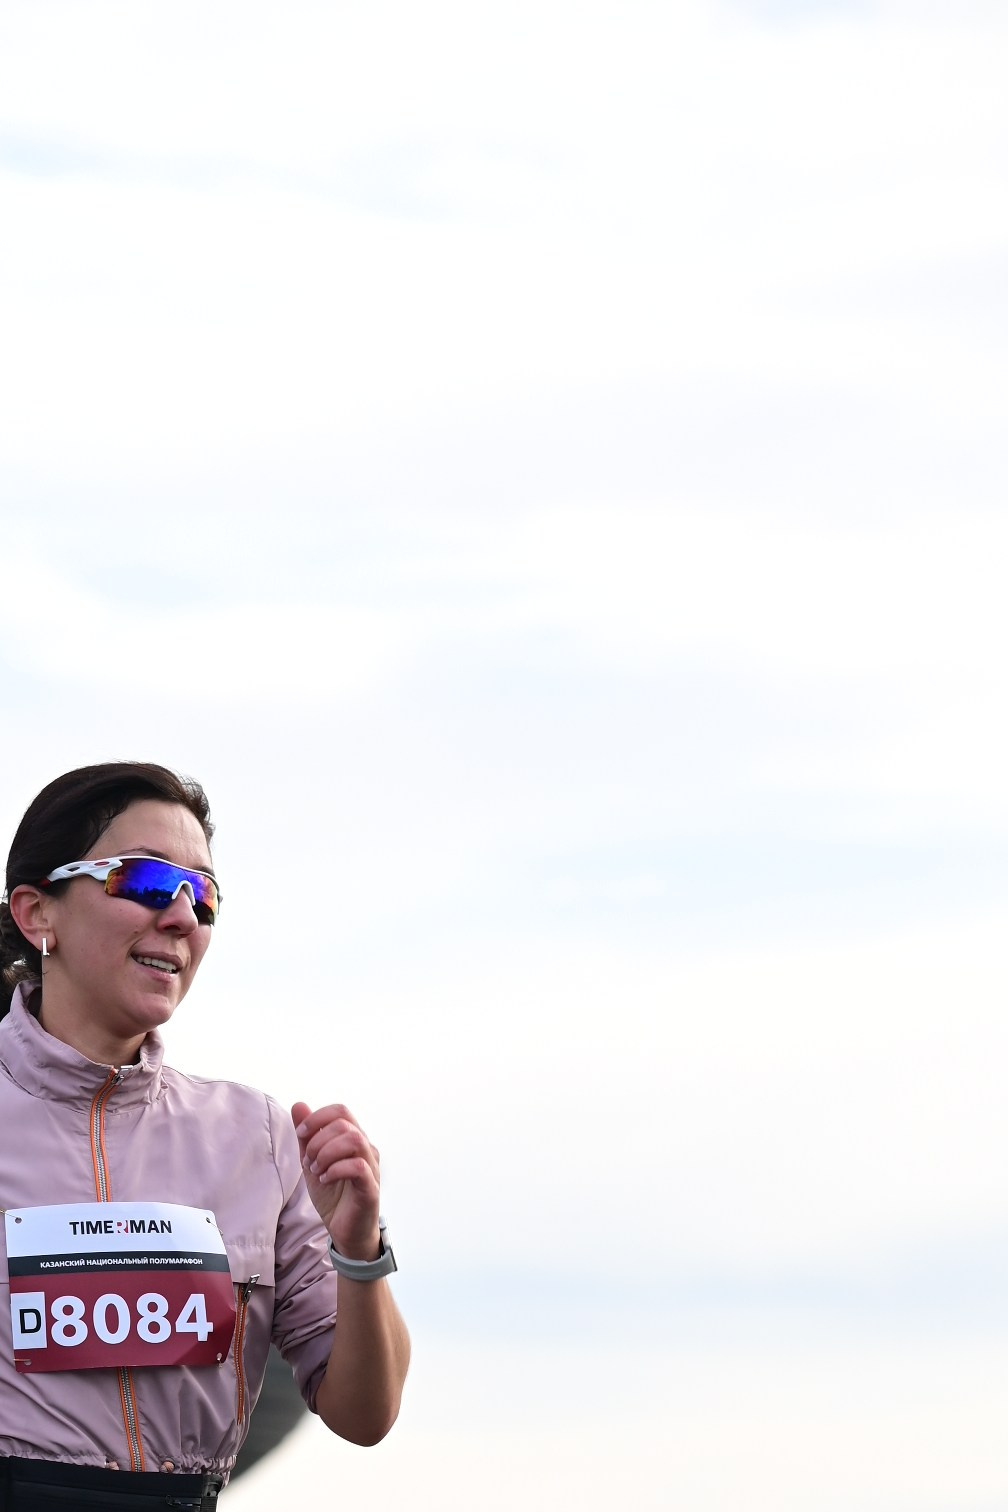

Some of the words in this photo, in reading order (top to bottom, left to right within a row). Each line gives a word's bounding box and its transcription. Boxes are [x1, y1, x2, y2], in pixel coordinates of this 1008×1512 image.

[40, 1259, 86, 1269] КАЗАНСКИЙ
[87, 1257, 148, 1266] НАЦИОНАЛЬНЫЙ
[149, 1257, 203, 1266] ПОЛУМАРАФОН
[19, 1308, 42, 1334] D
[50, 1292, 214, 1347] 8084
